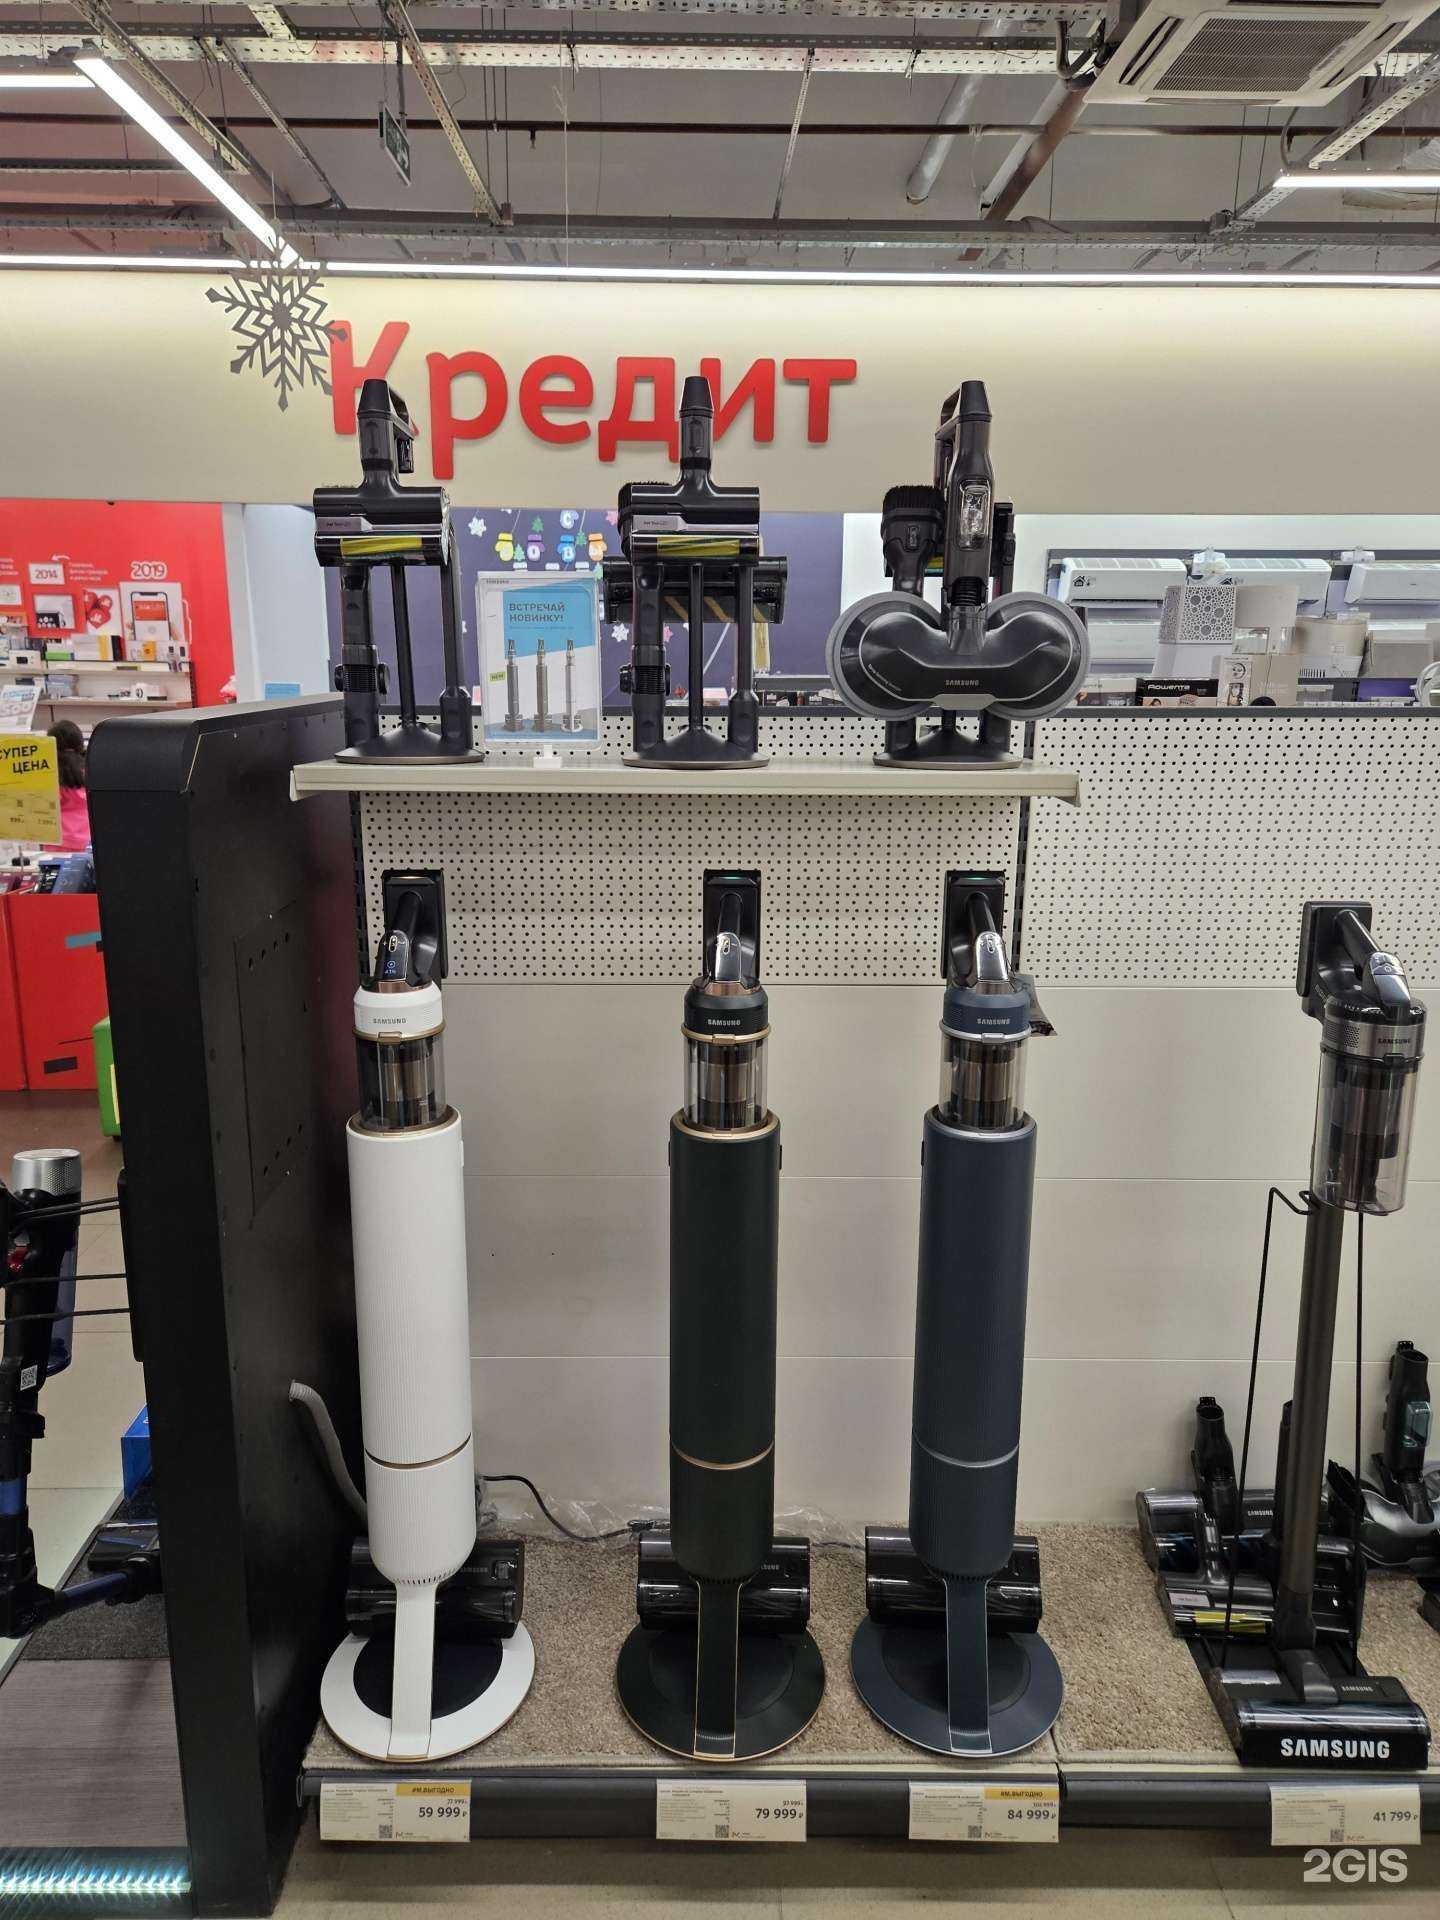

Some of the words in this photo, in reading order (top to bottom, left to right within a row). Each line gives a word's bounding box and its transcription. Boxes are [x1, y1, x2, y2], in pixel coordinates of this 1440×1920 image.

[329, 320, 858, 480] Кредит
[35, 569, 58, 580] 2014
[131, 561, 167, 579] 2019
[509, 602, 566, 612] ВСТРЕЧАЙ
[509, 613, 564, 623] НОВИНКУ!
[12, 759, 50, 775] ЦЕНА
[373, 1017, 407, 1025] SAMSUNG
[707, 1018, 741, 1026] SAMSUNG
[976, 1017, 1011, 1025] SAMSUNG
[1341, 1685, 1374, 1693] SAMSUNG
[1280, 1737, 1391, 1759] SAMSUNG
[418, 1806, 434, 1818] 59
[437, 1806, 461, 1818] 999
[755, 1808, 770, 1820] 79
[773, 1808, 797, 1819] 999
[1007, 1809, 1023, 1820] 84
[1026, 1809, 1050, 1820] 999
[1372, 1811, 1386, 1822] 41
[1389, 1811, 1411, 1822] 799
